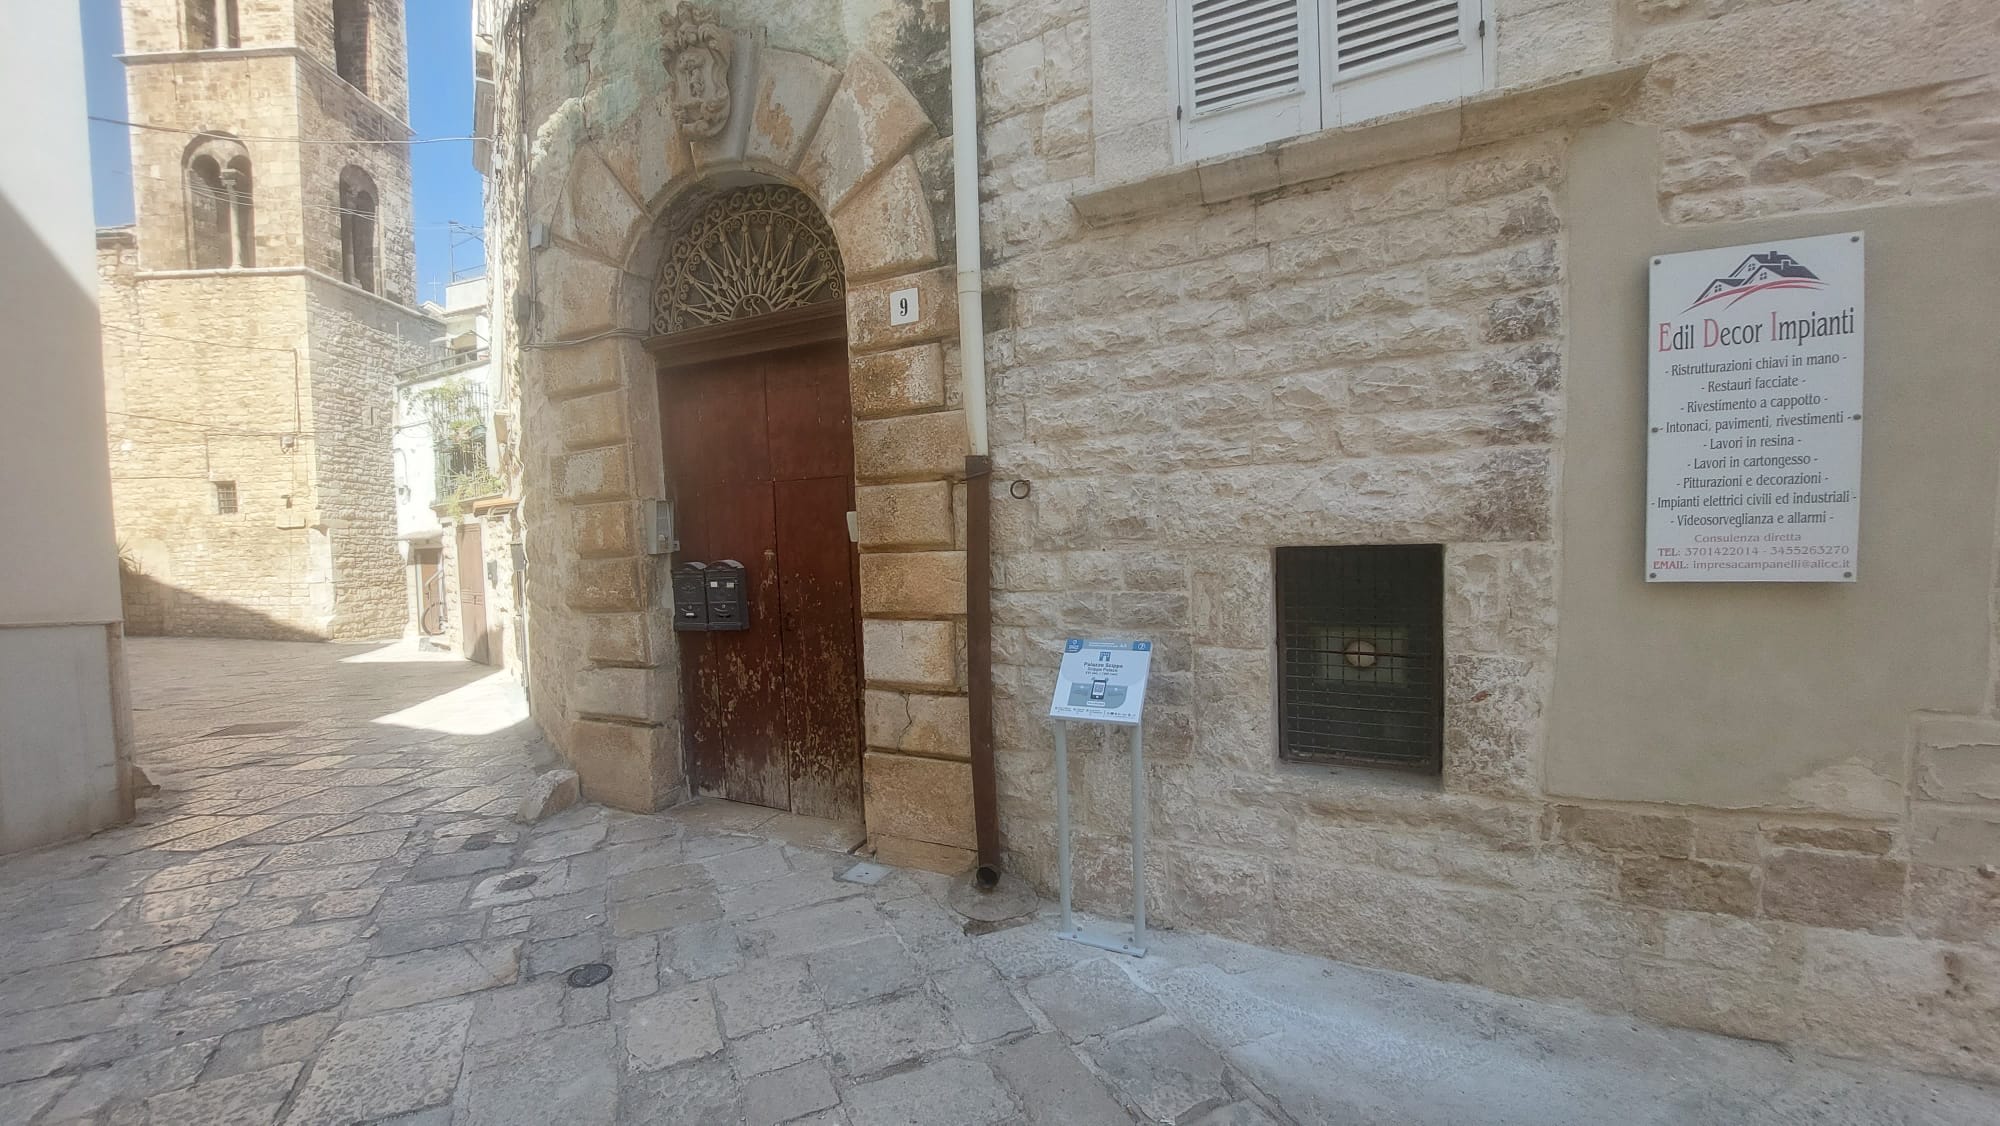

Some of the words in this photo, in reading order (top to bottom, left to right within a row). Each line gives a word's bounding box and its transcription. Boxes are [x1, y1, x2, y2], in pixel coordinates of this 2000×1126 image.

[900, 298, 908, 316] 9
[1658, 322, 1694, 352] Edil
[1703, 318, 1763, 347] Decor
[1771, 307, 1854, 346] Impianti
[1671, 358, 1752, 376] Ristrutturazioni
[1756, 355, 1788, 370] chiavi
[1792, 354, 1802, 366] in
[1807, 353, 1839, 365] mano
[1708, 379, 1751, 392] Restauri
[1755, 376, 1798, 389] facciate
[1687, 397, 1757, 413] Rivestimento
[1760, 399, 1767, 408] a
[1770, 393, 1820, 410] cappotto
[1666, 420, 1711, 433] Intonaci,
[1715, 415, 1772, 433] pavimenti,
[1776, 411, 1843, 427] rivestimenti
[1710, 437, 1742, 449] Lavori
[1747, 436, 1756, 448] in
[1760, 434, 1794, 446] resina
[1694, 457, 1726, 469] Lavori
[1730, 456, 1739, 467] in
[1743, 454, 1810, 469] cartongesso
[1683, 475, 1742, 488] Pitturazioni
[1746, 477, 1752, 486] e
[1756, 472, 1821, 486] decorazioni
[1657, 496, 1700, 511] Impianti
[1703, 494, 1743, 507] elettrici
[1747, 493, 1771, 505] civili
[1775, 493, 1789, 504] ed
[1793, 490, 1849, 504] industriali
[1677, 513, 1774, 528] Videosorveglianza
[1777, 514, 1784, 523] e
[1788, 511, 1826, 523] allarmi
[1694, 533, 1760, 543] Consulenza
[1764, 533, 1801, 542] diretta
[1658, 548, 1680, 557] TEL:
[1653, 560, 1689, 570] EMAIL:
[1693, 559, 1850, 571] impresacampanelli@alice.it
